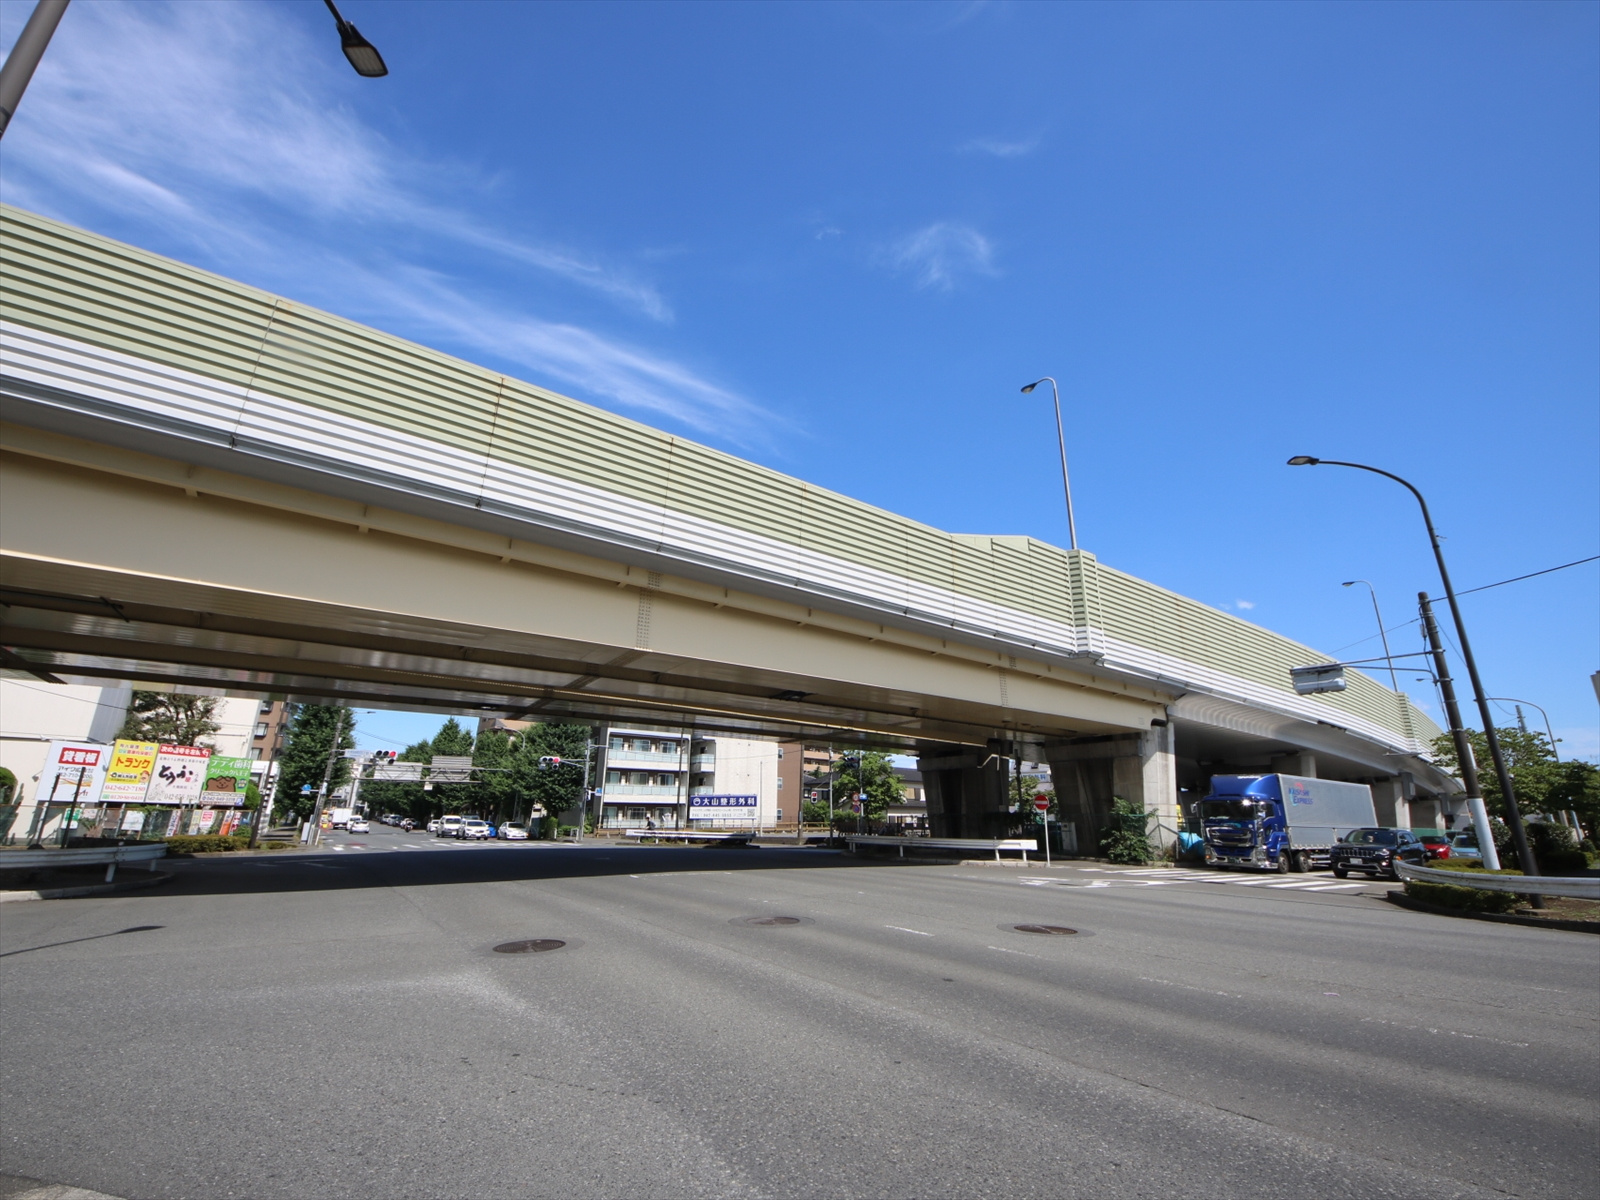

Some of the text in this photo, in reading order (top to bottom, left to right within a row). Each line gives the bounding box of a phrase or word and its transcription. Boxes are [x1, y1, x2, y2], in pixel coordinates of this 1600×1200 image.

[116, 757, 151, 769] トランク
[211, 758, 252, 769] テディ歯科
[702, 797, 755, 806] 大山整形外科
